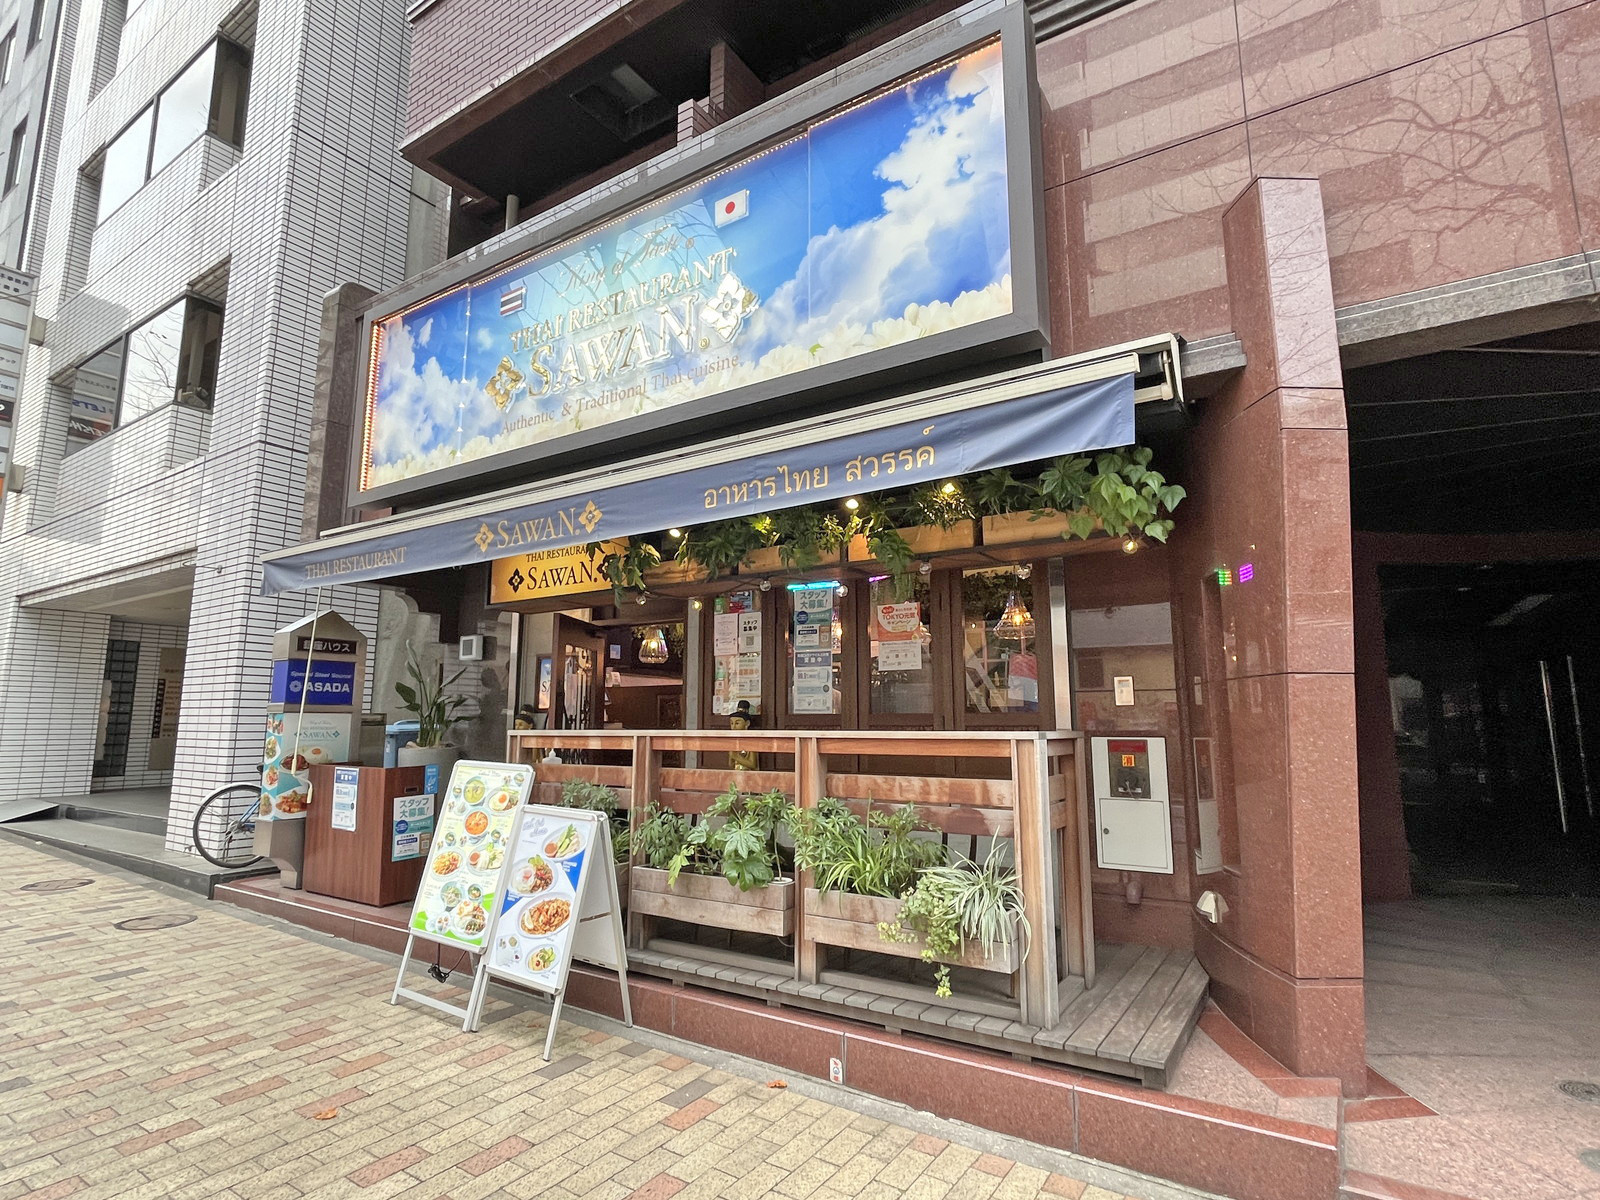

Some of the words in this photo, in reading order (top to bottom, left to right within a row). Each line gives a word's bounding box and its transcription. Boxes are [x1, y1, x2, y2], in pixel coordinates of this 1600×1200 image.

[509, 314, 564, 353] THAI
[568, 246, 738, 333] RESTAURANT
[501, 409, 555, 434] Authentic
[561, 402, 573, 416] &
[576, 376, 647, 412] Traditional
[651, 371, 683, 391] Thai
[686, 354, 740, 381] cuisine
[704, 464, 829, 509] อาหารไทย
[845, 424, 936, 482] สวรรค์
[304, 564, 330, 580] THAI
[332, 546, 408, 575] RESTAURANT
[526, 552, 545, 563] THAI
[546, 544, 591, 560] RESTAURA
[800, 590, 827, 600] スタッフ
[306, 682, 350, 693] ASADA
[400, 798, 430, 810] スタッフ
